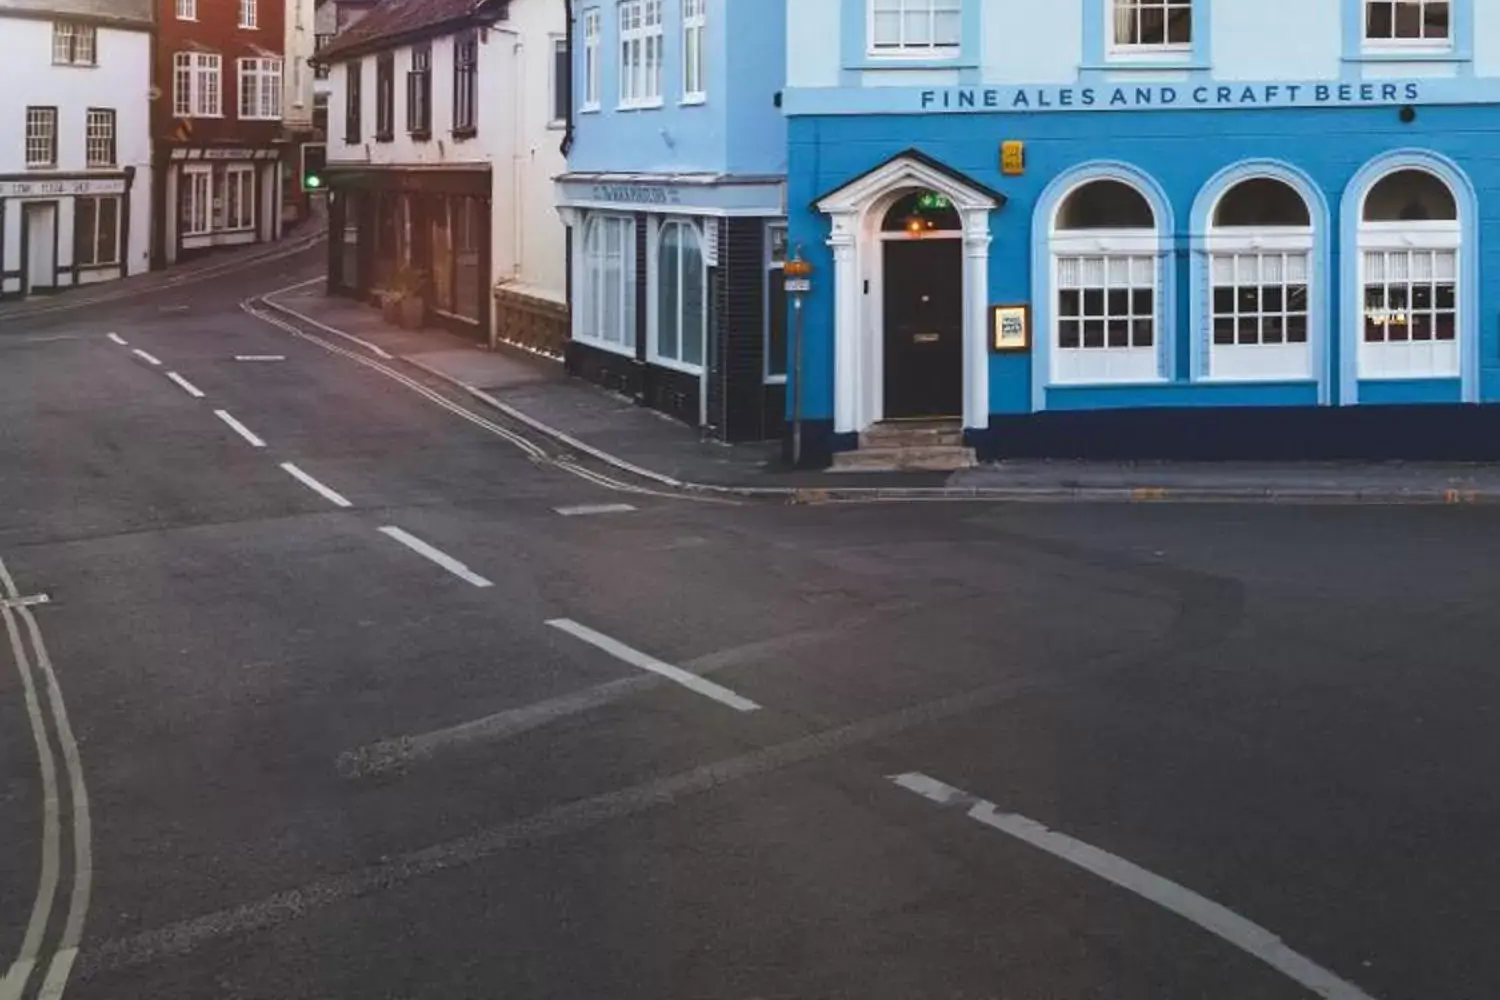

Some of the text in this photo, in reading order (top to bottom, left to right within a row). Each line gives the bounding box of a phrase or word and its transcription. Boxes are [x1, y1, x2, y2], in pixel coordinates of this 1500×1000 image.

[921, 83, 1419, 109] FINE ALES AND CRAFT BEERS
